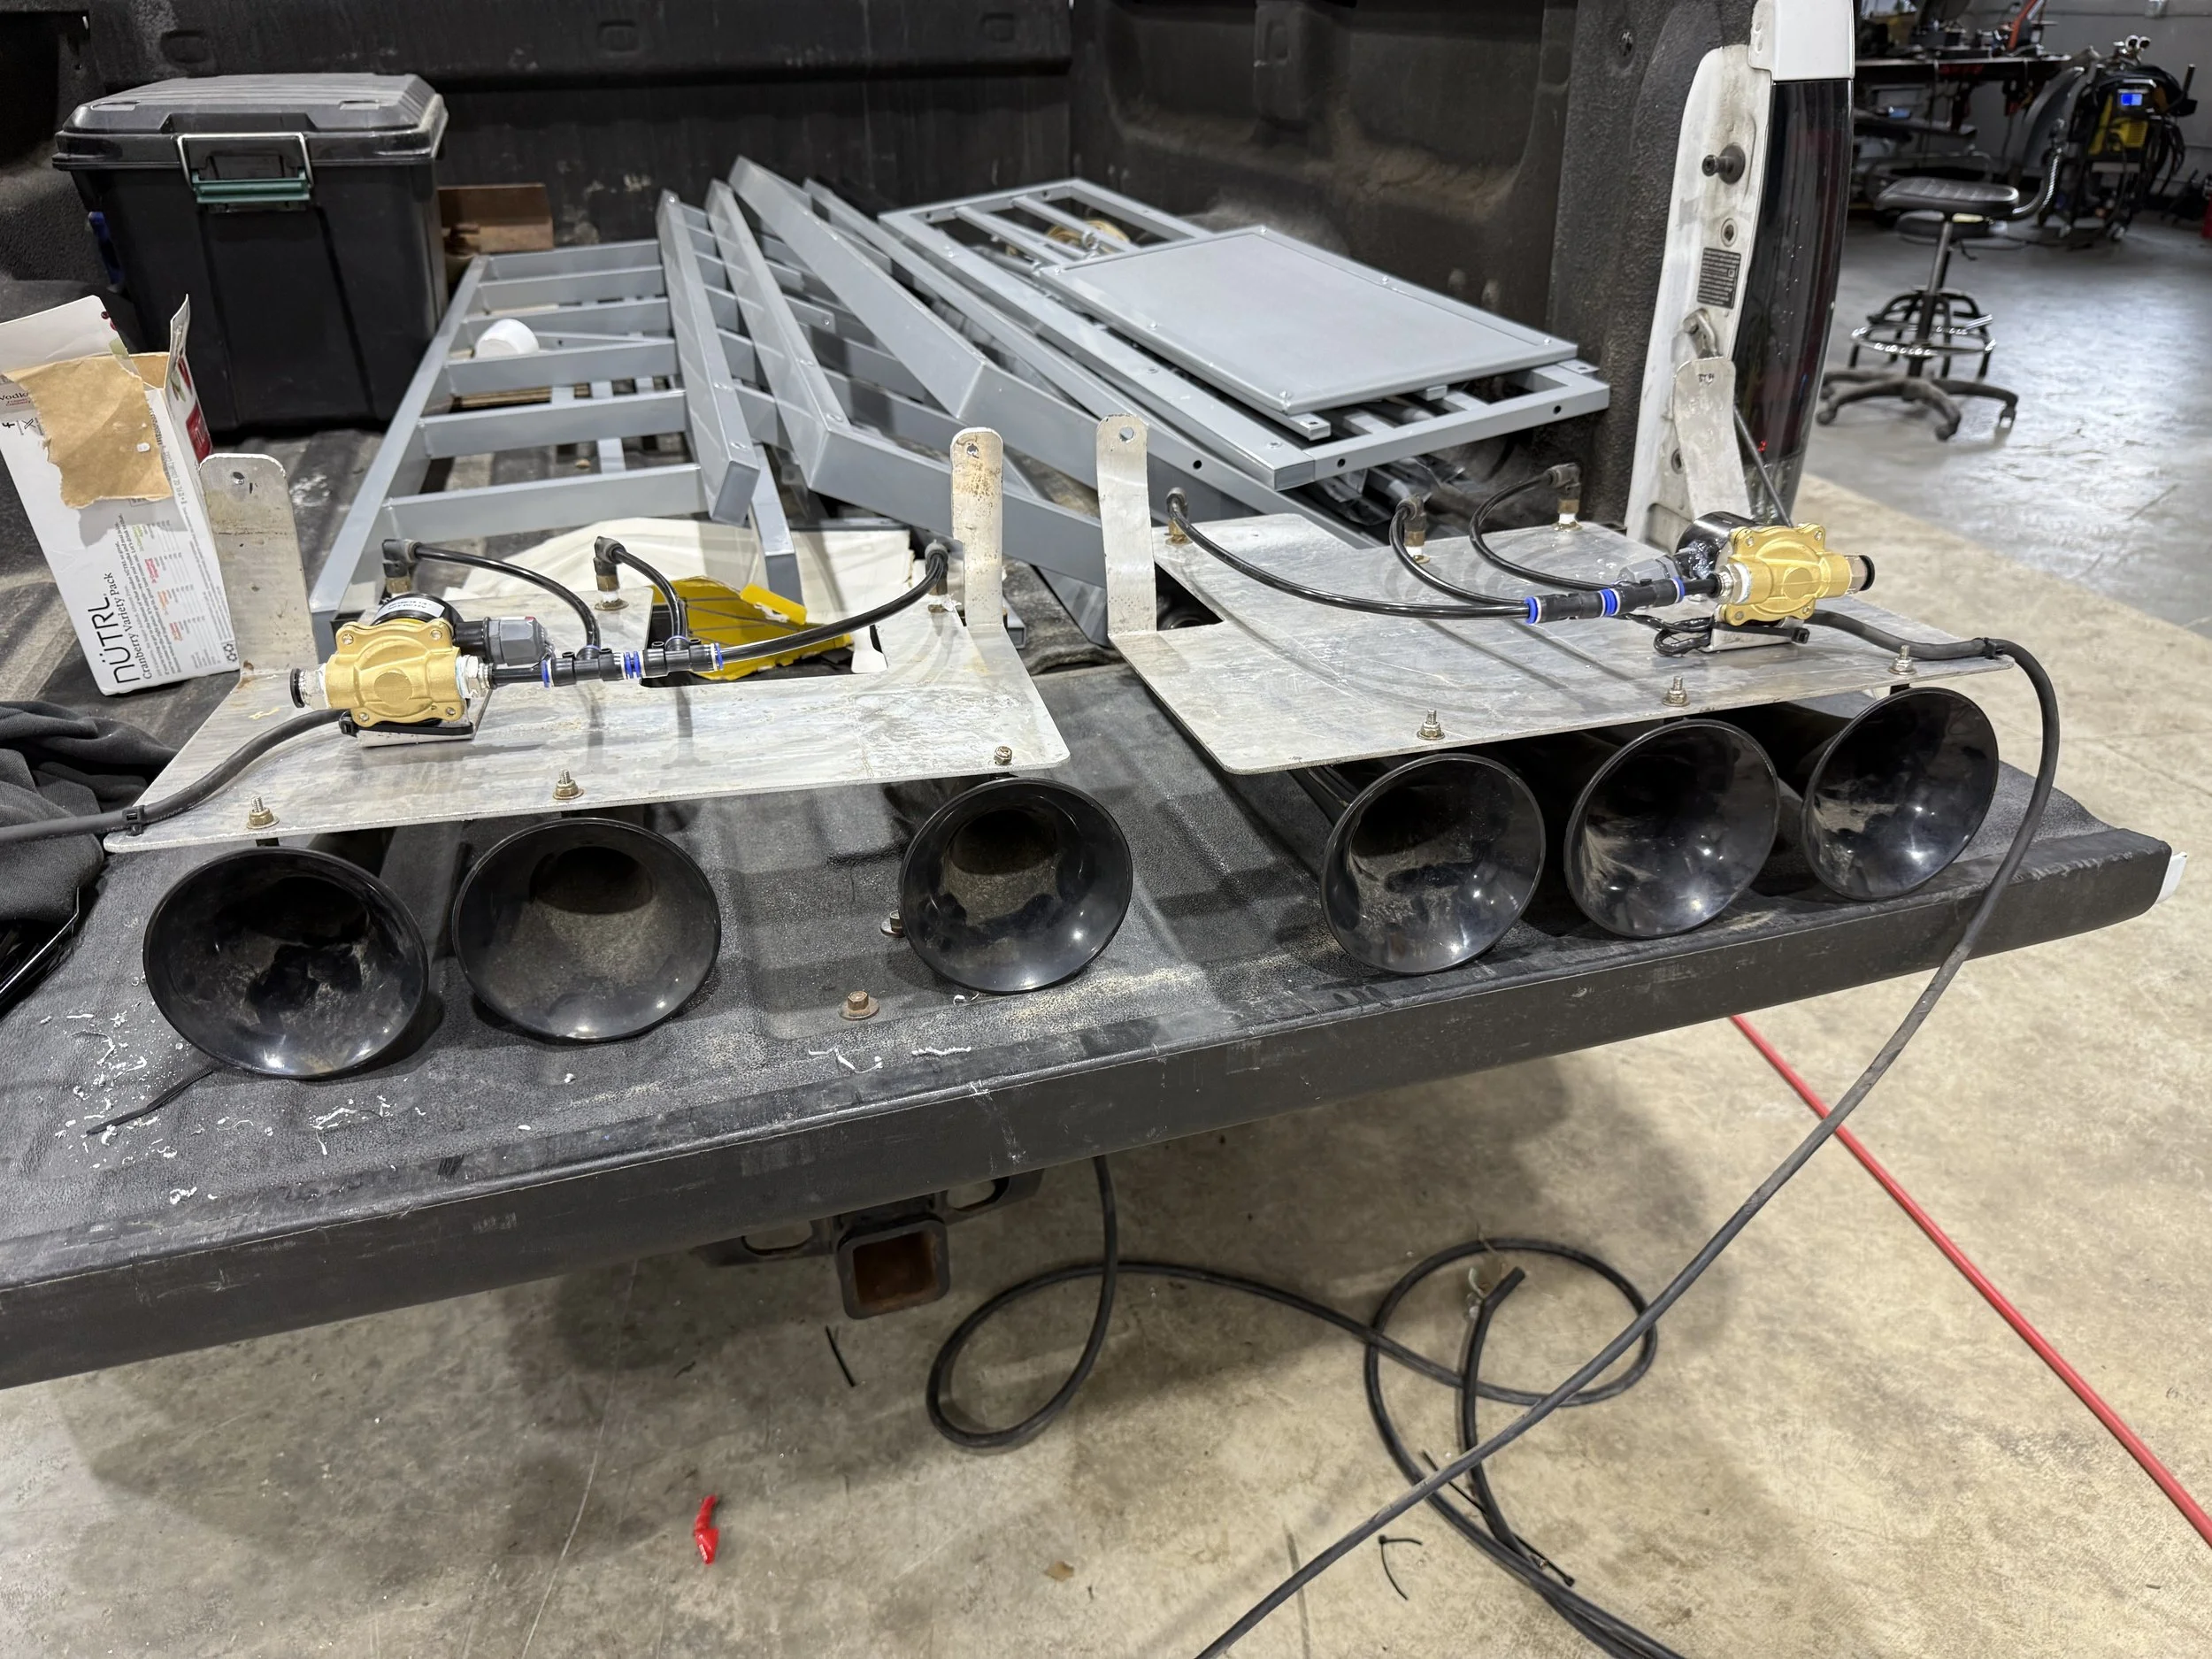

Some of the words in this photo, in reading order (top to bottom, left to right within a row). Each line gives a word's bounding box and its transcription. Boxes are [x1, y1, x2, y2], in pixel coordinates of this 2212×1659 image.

[104, 572, 119, 595] Pack
[114, 597, 132, 632] Variety
[129, 633, 152, 680] Cranberry
